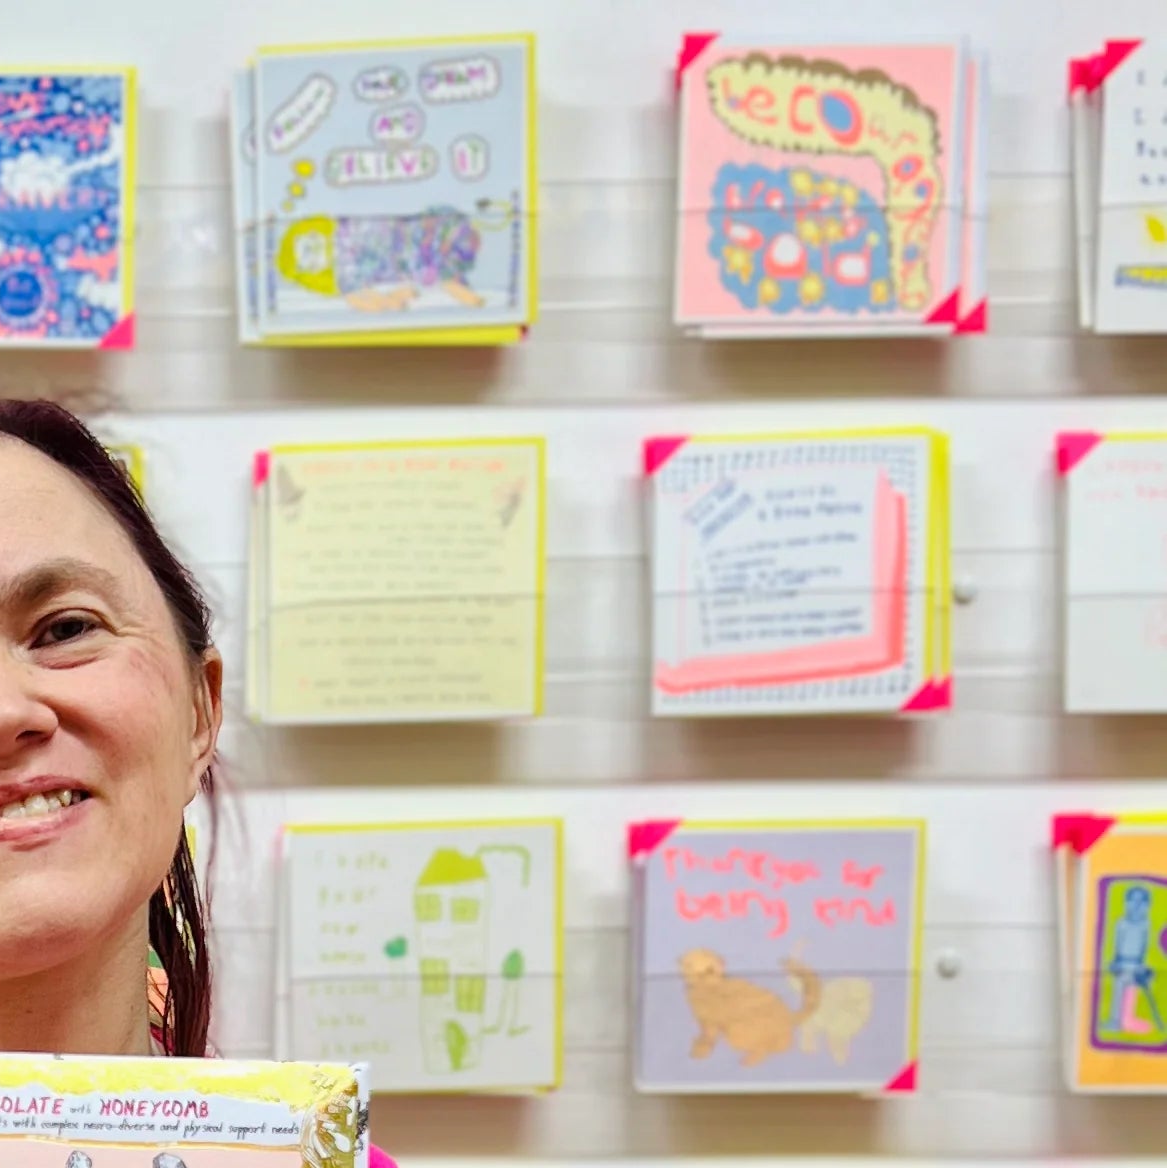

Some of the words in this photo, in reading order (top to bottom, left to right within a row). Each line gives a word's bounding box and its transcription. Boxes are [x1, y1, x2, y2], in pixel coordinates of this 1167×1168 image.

[99, 1098, 209, 1117] HONEYCOMB
[13, 1116, 36, 1129] with
[40, 1119, 78, 1137] complex
[160, 1120, 179, 1133] and
[228, 1122, 266, 1140] support
[271, 1123, 299, 1136] needs
